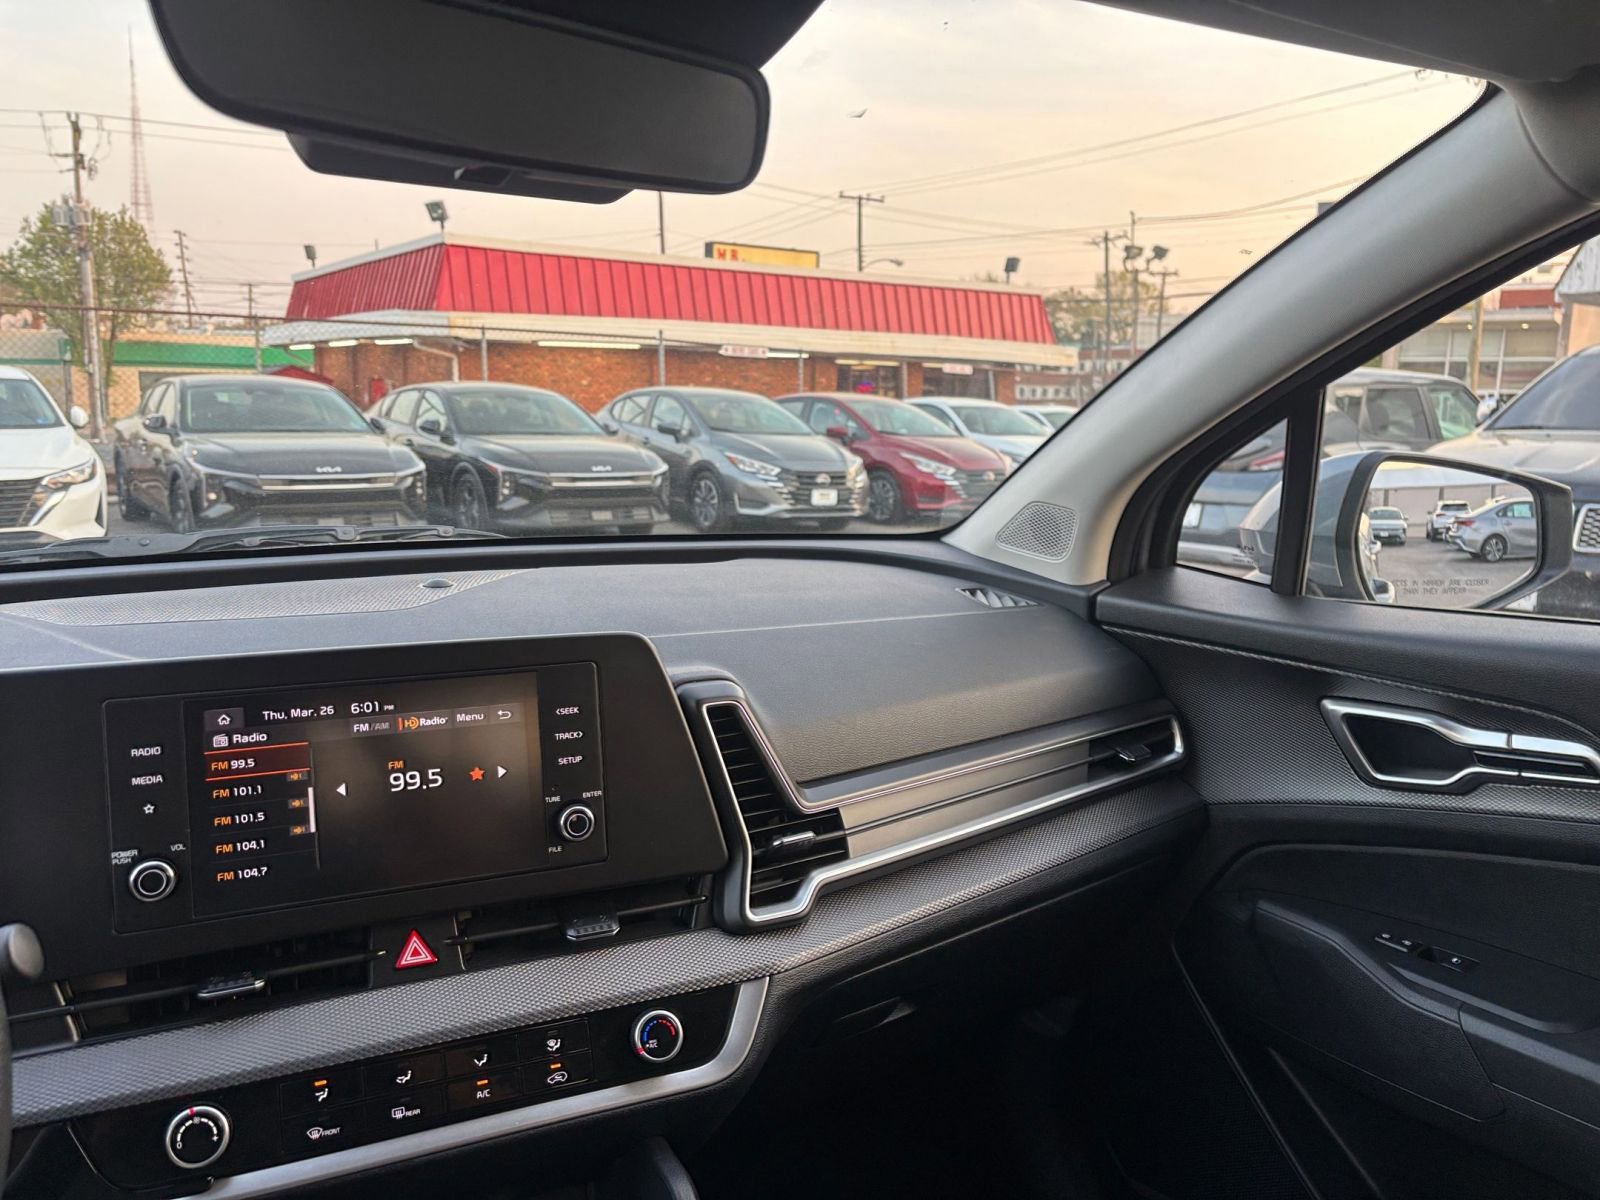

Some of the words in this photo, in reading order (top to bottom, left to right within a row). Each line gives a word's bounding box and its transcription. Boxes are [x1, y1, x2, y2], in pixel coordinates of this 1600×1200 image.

[350, 701, 380, 714] 6:01
[262, 710, 288, 721] Thu.
[290, 707, 318, 719] Mar.
[319, 705, 335, 716] 26
[456, 712, 485, 722] Menu
[232, 732, 267, 744] Radio
[131, 746, 161, 757] RADIO
[210, 761, 229, 771] FM
[230, 758, 256, 769] 99.5
[387, 760, 405, 770] FM
[558, 756, 583, 765] SETUP
[131, 775, 163, 785] MEDIA
[389, 768, 444, 792] 99.5
[212, 788, 231, 799] FM
[233, 784, 263, 797] 101.1
[582, 790, 603, 799] ENTER
[544, 795, 561, 803] TUNE
[213, 815, 232, 827] FM
[234, 811, 266, 824] 101.5
[170, 843, 186, 852] VOL
[215, 843, 234, 855] FM
[236, 839, 266, 852] 104.1
[548, 845, 563, 853] FILE
[111, 849, 138, 858] POWER
[112, 857, 132, 865] PUSH
[217, 871, 235, 882] FM
[237, 866, 268, 880] 104.7
[476, 1089, 491, 1099] A/C
[405, 1108, 421, 1117] REAR
[321, 1127, 341, 1137] FRONT
